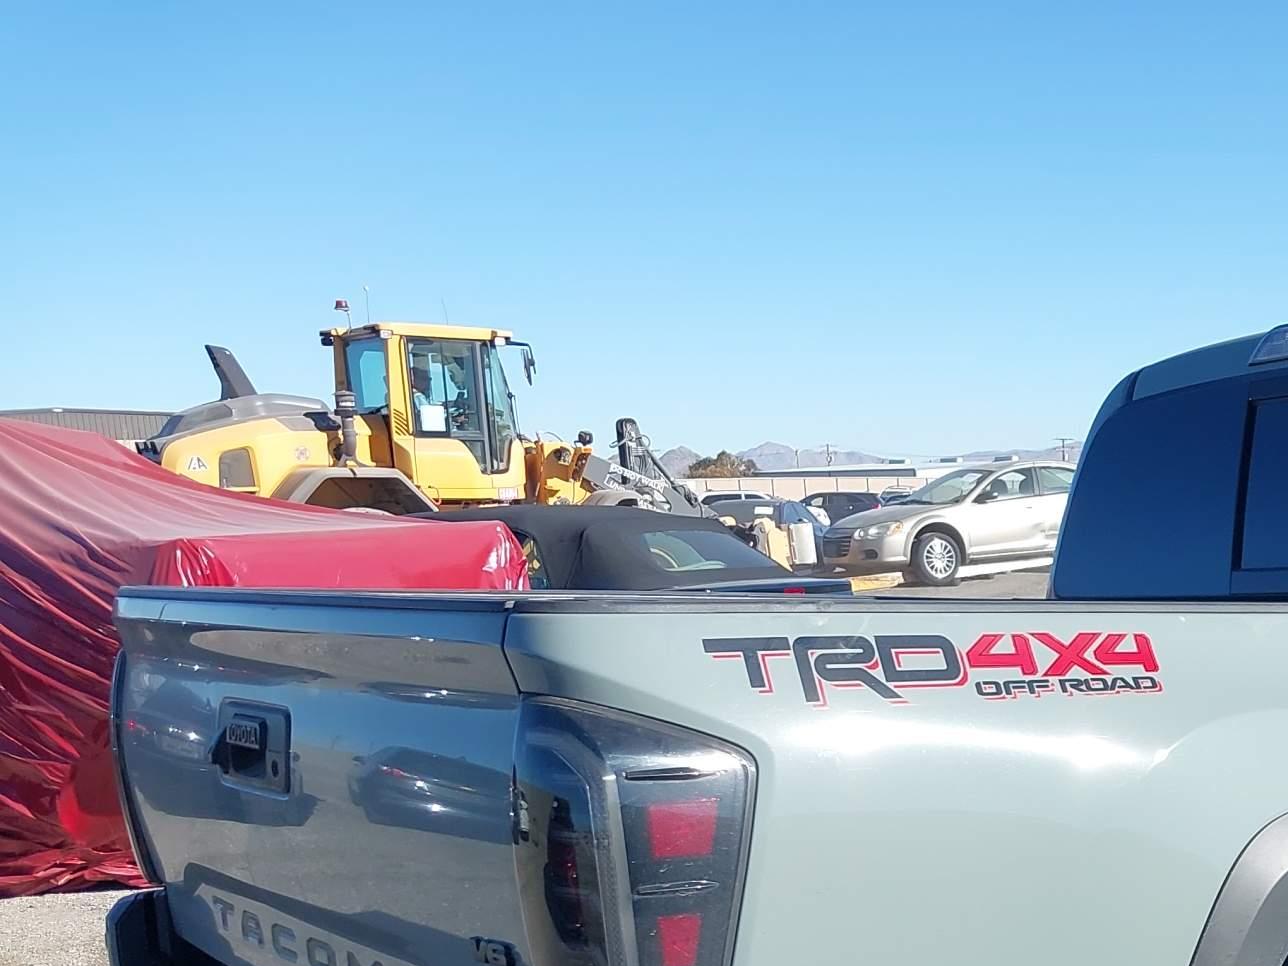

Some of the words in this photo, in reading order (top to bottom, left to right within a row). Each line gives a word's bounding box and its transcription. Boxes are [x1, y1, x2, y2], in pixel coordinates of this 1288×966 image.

[701, 635, 968, 706] TRD
[966, 632, 1159, 677] 4X4
[975, 680, 1054, 699] OFF
[1059, 675, 1163, 695] ROAD
